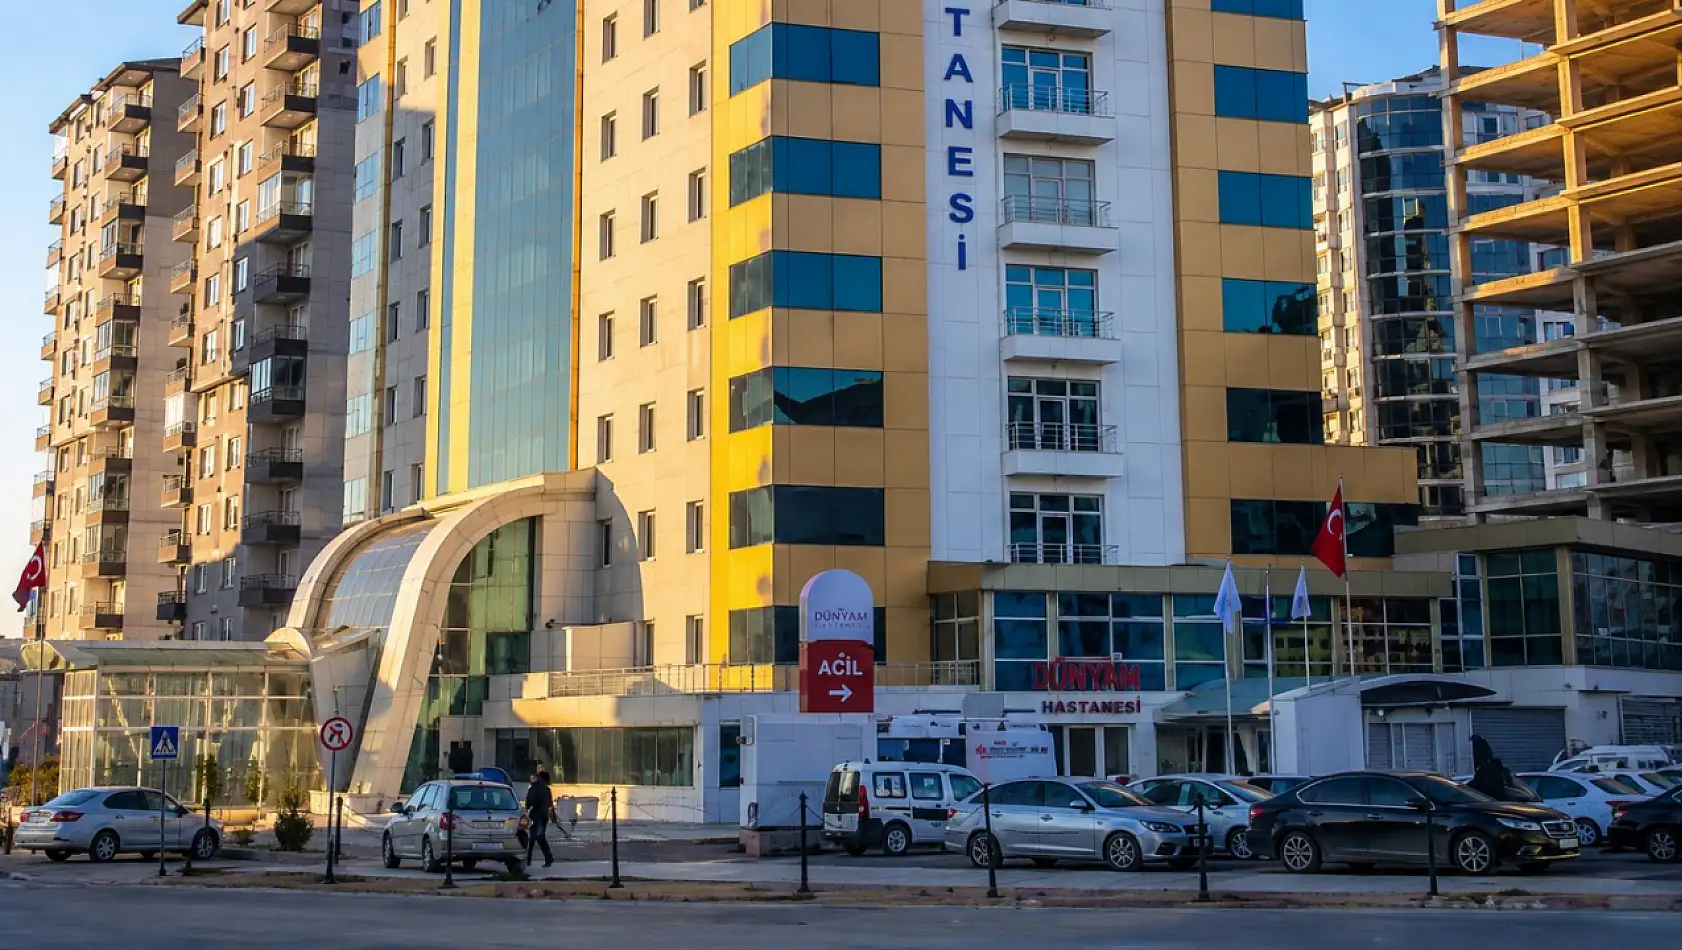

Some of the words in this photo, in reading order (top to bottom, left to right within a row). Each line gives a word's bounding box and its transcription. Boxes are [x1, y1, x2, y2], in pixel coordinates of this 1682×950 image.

[944, 7, 974, 271] TANESİ
[818, 654, 863, 675] ACİL
[1034, 656, 1140, 691] DÜNYAM
[1042, 696, 1141, 714] HASTANESİ
